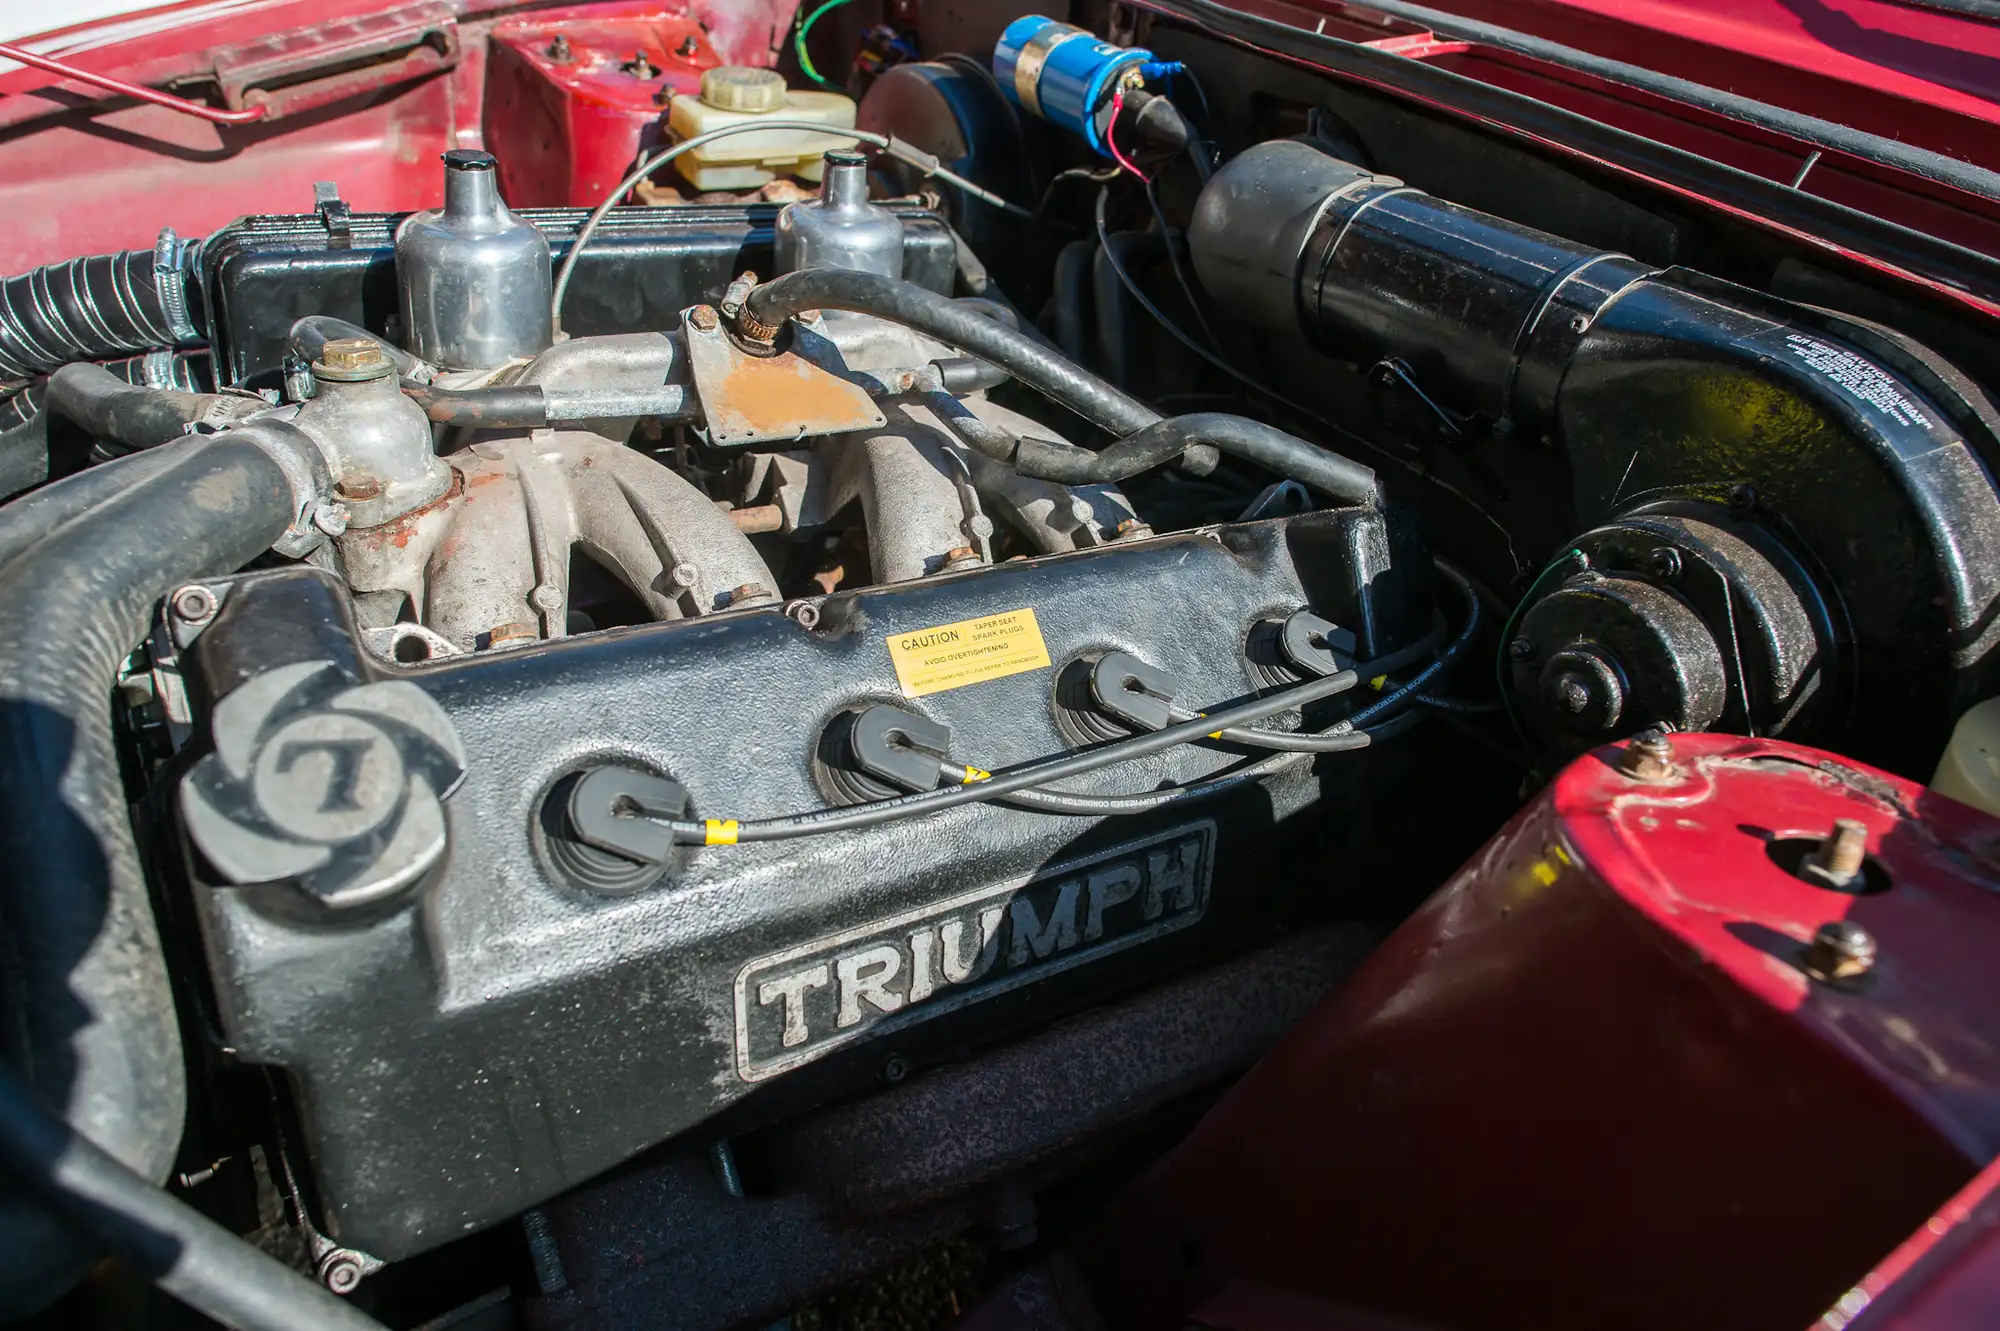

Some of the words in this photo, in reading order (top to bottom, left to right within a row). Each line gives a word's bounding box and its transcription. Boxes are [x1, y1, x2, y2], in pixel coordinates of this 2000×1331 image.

[1842, 350, 1893, 385] CAUTION
[974, 621, 997, 630] TAPER
[999, 616, 1016, 626] SEAT
[902, 630, 959, 650] CAUTION
[972, 630, 998, 641] SPARK
[1000, 625, 1024, 635] PLUGS
[924, 655, 946, 666] AVOID
[948, 643, 1009, 661] OVERTIGHTENING
[1350, 686, 1408, 724] ELECTROSPORTS
[1041, 794, 1056, 802] ALL
[1062, 797, 1108, 807] CONDUCTOR
[1110, 797, 1155, 807] SUPPRESSED
[759, 841, 1196, 1047] TRIUMPH
